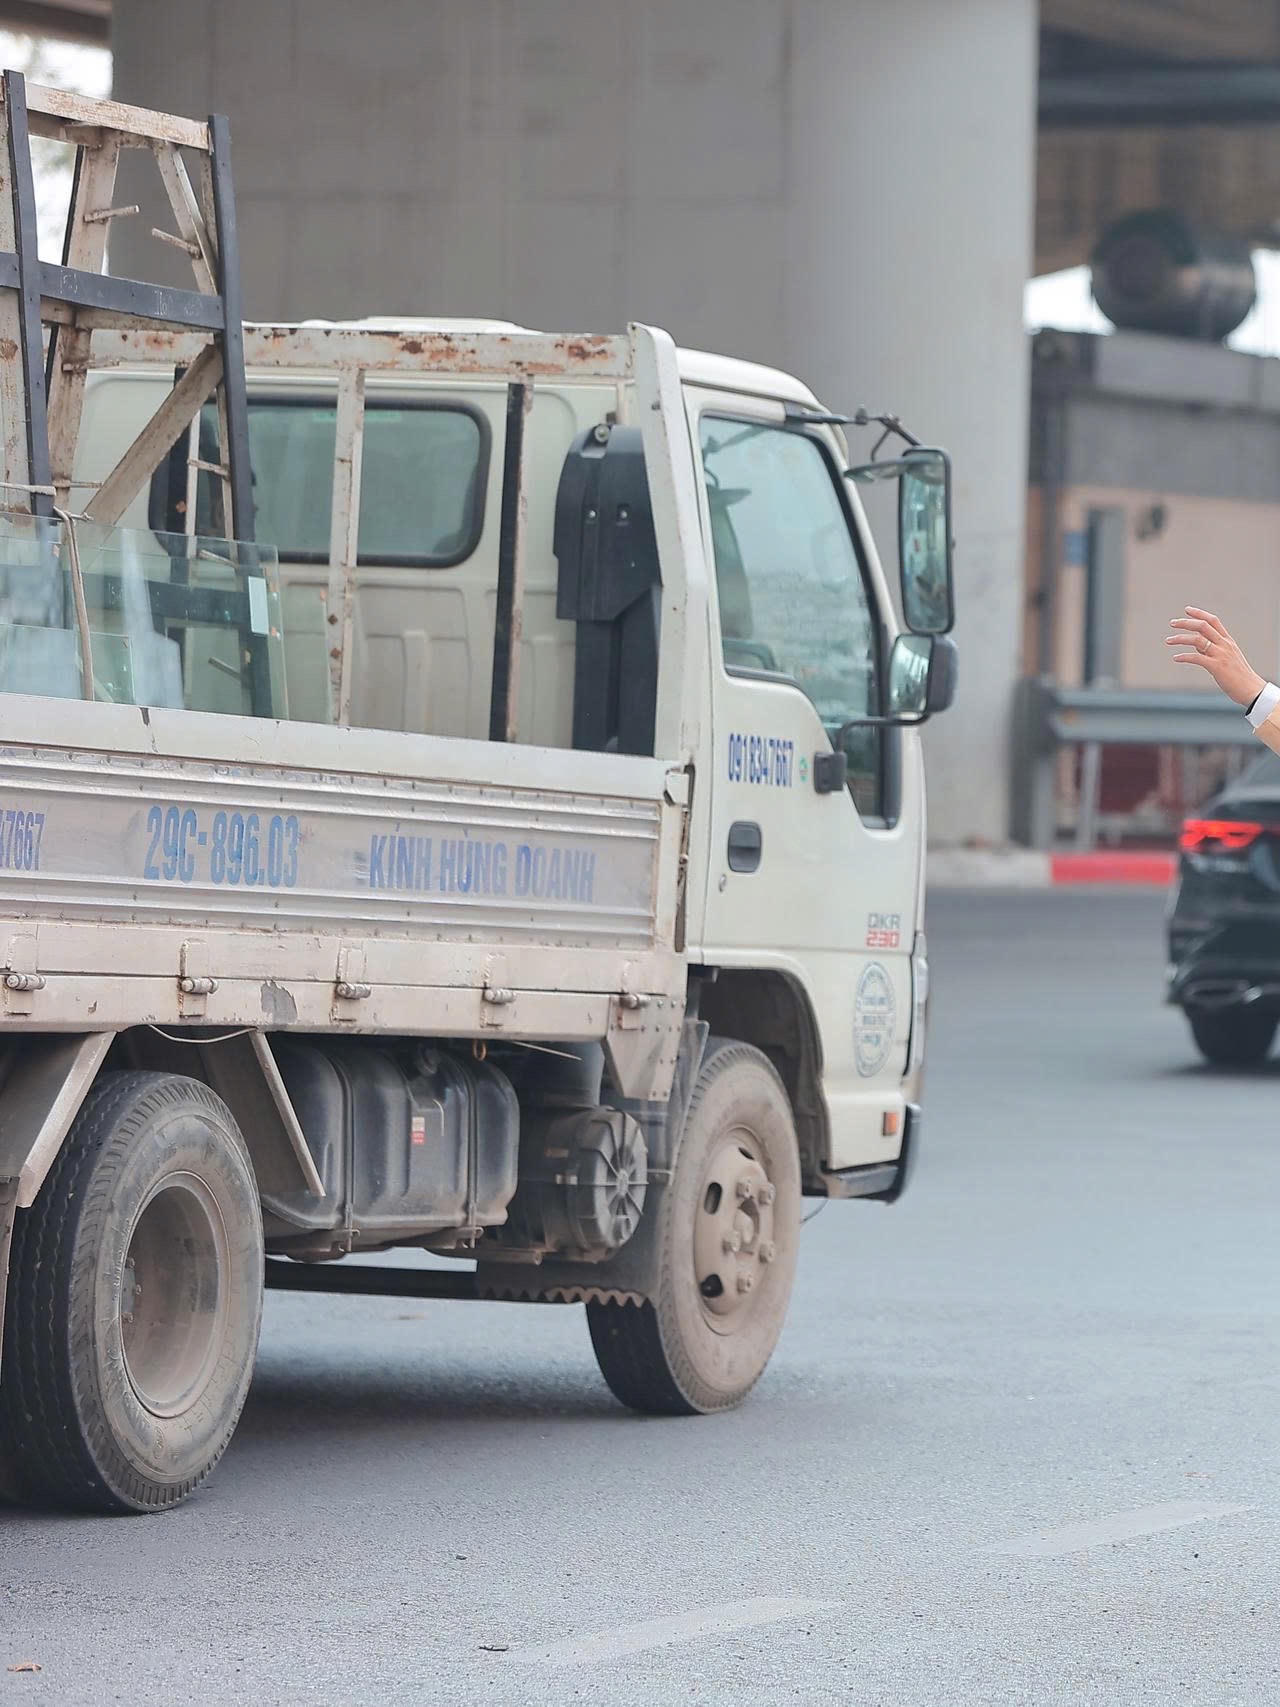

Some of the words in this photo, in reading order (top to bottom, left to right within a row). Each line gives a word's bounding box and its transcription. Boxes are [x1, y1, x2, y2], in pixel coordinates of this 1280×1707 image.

[143, 805, 299, 888] 29C-896.03
[369, 823, 432, 890] KÍNH
[514, 844, 597, 903] DOANH
